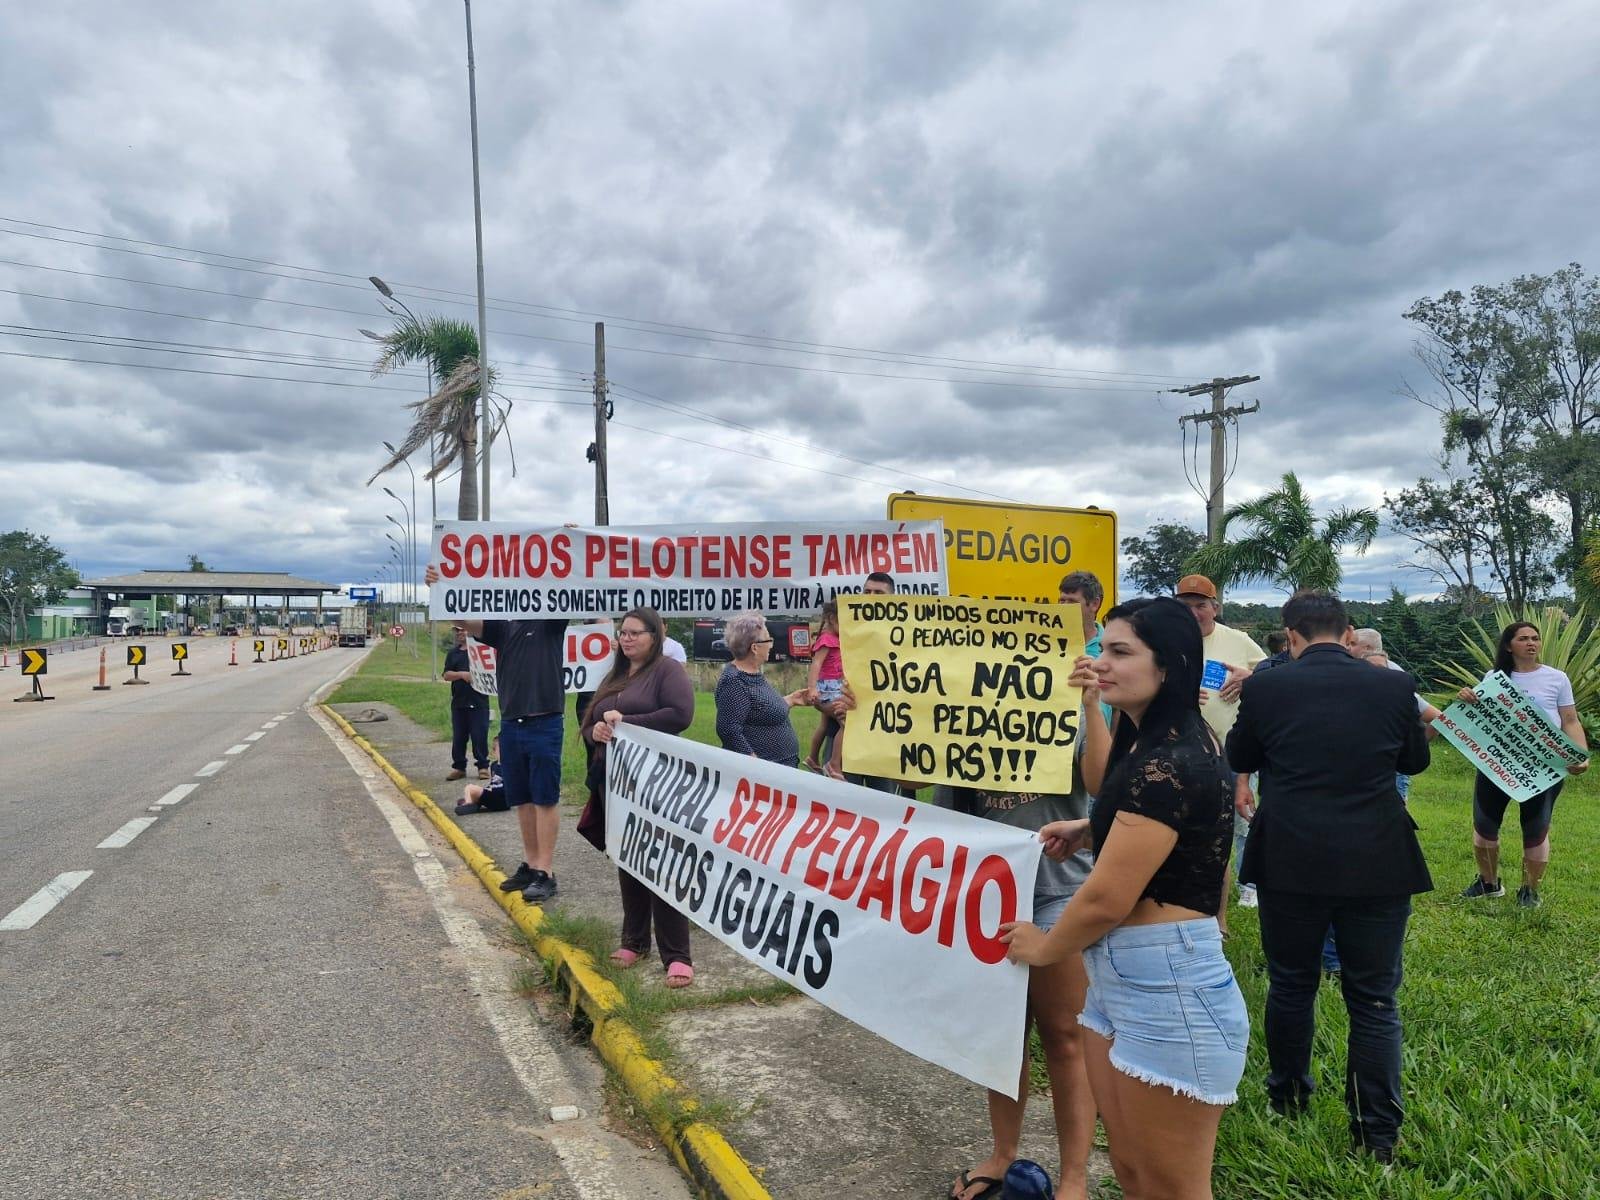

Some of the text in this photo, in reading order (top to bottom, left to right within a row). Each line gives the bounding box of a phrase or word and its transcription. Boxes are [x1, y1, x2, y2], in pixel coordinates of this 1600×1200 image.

[440, 523, 939, 578] SOMOS PELOTENSE TAMBÉM
[446, 589, 541, 613] QUEREMOS
[547, 589, 628, 612] SOMENTE
[634, 589, 645, 610] O
[652, 588, 715, 612] DIREITO
[722, 588, 742, 609] DE
[748, 588, 763, 610] IR
[769, 588, 778, 609] E
[783, 587, 810, 609] VIR
[848, 601, 908, 622] TODOS
[915, 599, 982, 623] UNIDOS
[986, 608, 1064, 629] CONTRA
[890, 626, 904, 646] O
[913, 625, 985, 648] PEDAGIO
[992, 630, 1018, 651] NO
[870, 652, 1053, 701] DIGA NÃO
[1494, 673, 1524, 704] JUNTOS
[1483, 697, 1498, 709] RS
[870, 700, 1078, 747] AOS PEDÁGIOS
[1454, 728, 1481, 754] CONTRA
[900, 743, 936, 775] NO
[640, 752, 720, 834] RURAL
[713, 777, 797, 865] SEM
[781, 801, 1017, 964] PEDÁGIO
[619, 812, 839, 990] DIREITOS IGUAIS
